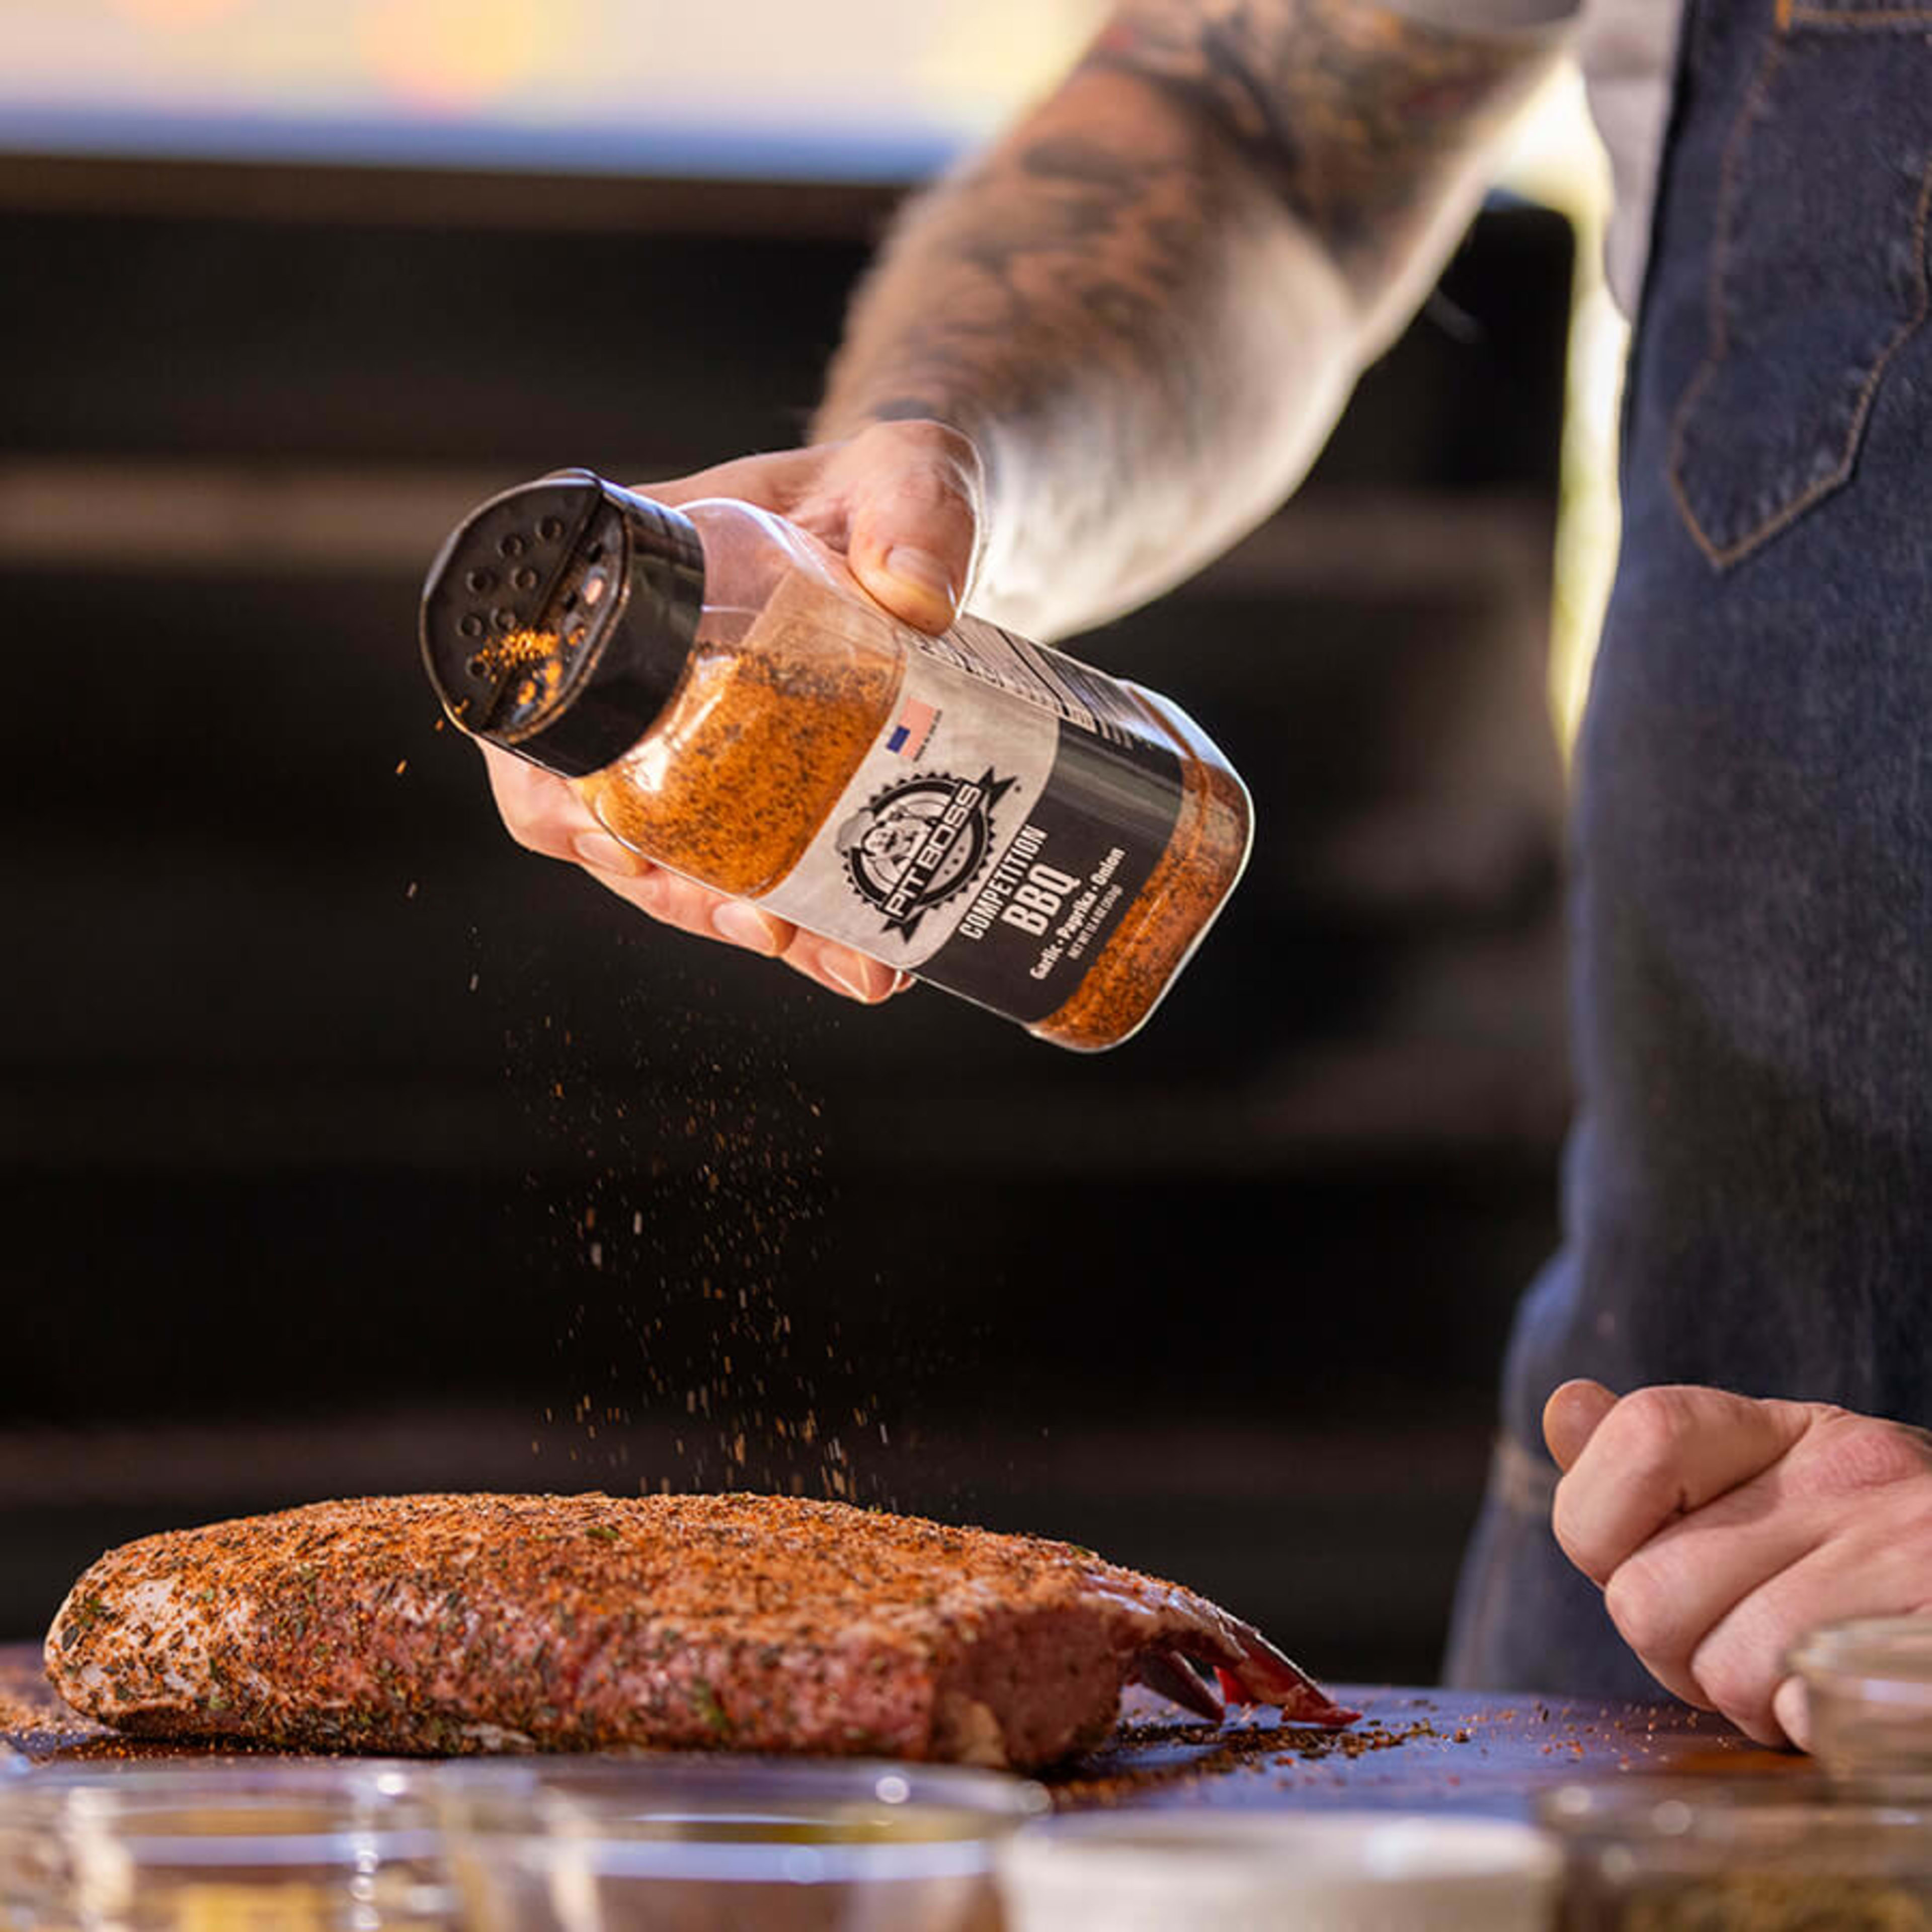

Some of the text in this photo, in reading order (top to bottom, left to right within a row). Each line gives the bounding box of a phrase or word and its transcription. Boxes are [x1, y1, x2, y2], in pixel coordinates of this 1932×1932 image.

[884, 867, 925, 916] PIT
[916, 784, 981, 870] BOSS
[958, 824, 1049, 939] COMPETITION
[1001, 863, 1081, 936] BBQ
[1030, 847, 1125, 979] Garlic Paprika Onion
